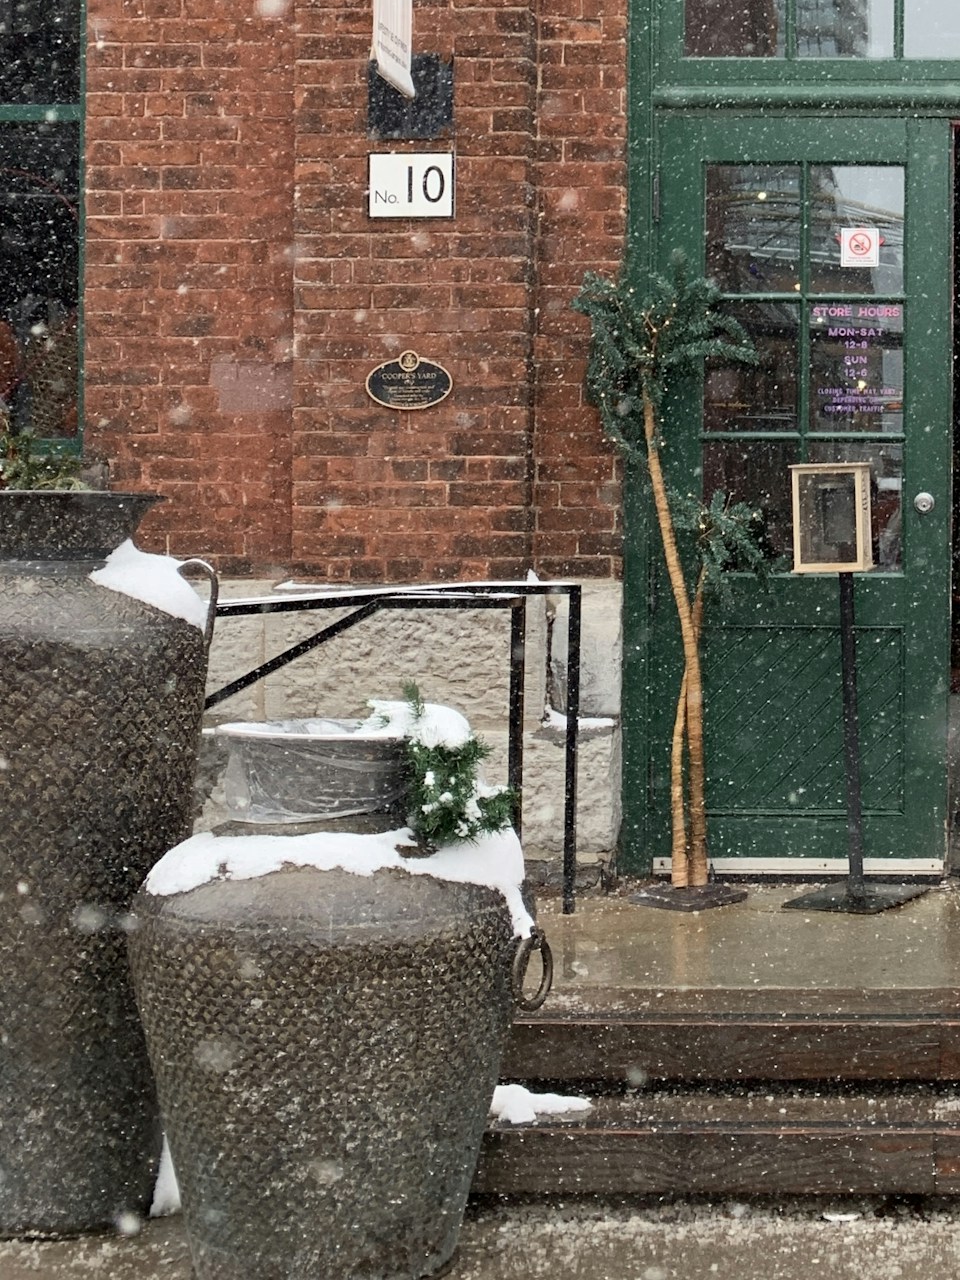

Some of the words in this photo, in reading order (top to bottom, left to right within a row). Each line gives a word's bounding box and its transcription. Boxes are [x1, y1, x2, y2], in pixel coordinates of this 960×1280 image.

[374, 190, 400, 205] No.
[407, 165, 445, 204] 10
[813, 307, 852, 317] STORE
[858, 307, 900, 317] HOURS
[828, 327, 884, 337] MON-SAT
[844, 341, 868, 349] 12-8
[844, 356, 868, 364] SUN
[417, 372, 437, 380] YARD
[844, 369, 868, 377] 12-6
